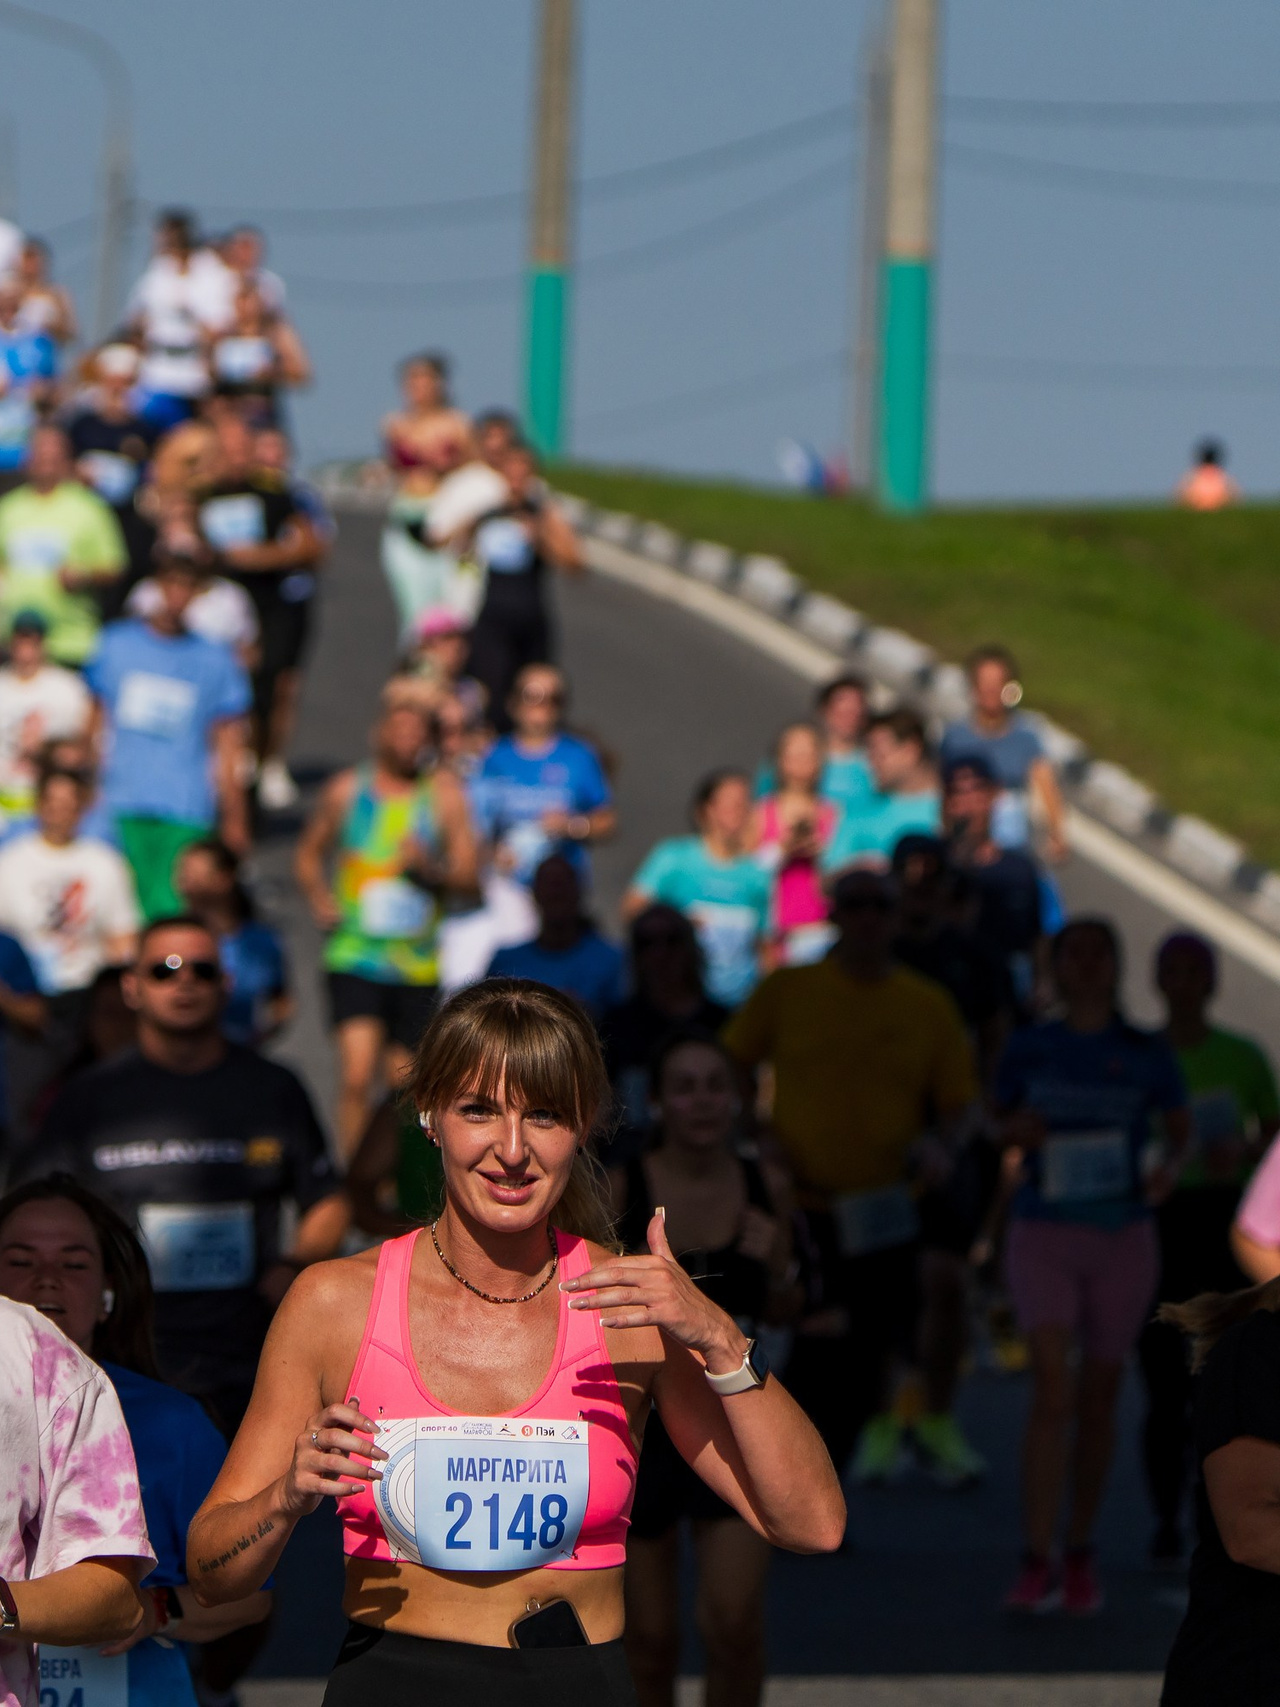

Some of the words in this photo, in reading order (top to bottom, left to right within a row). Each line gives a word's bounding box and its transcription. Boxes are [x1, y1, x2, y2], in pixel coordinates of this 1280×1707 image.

[536, 1426, 555, 1437] Пэй
[447, 1458, 567, 1484] МАРГАРИТА
[445, 1492, 568, 1551] 2148
